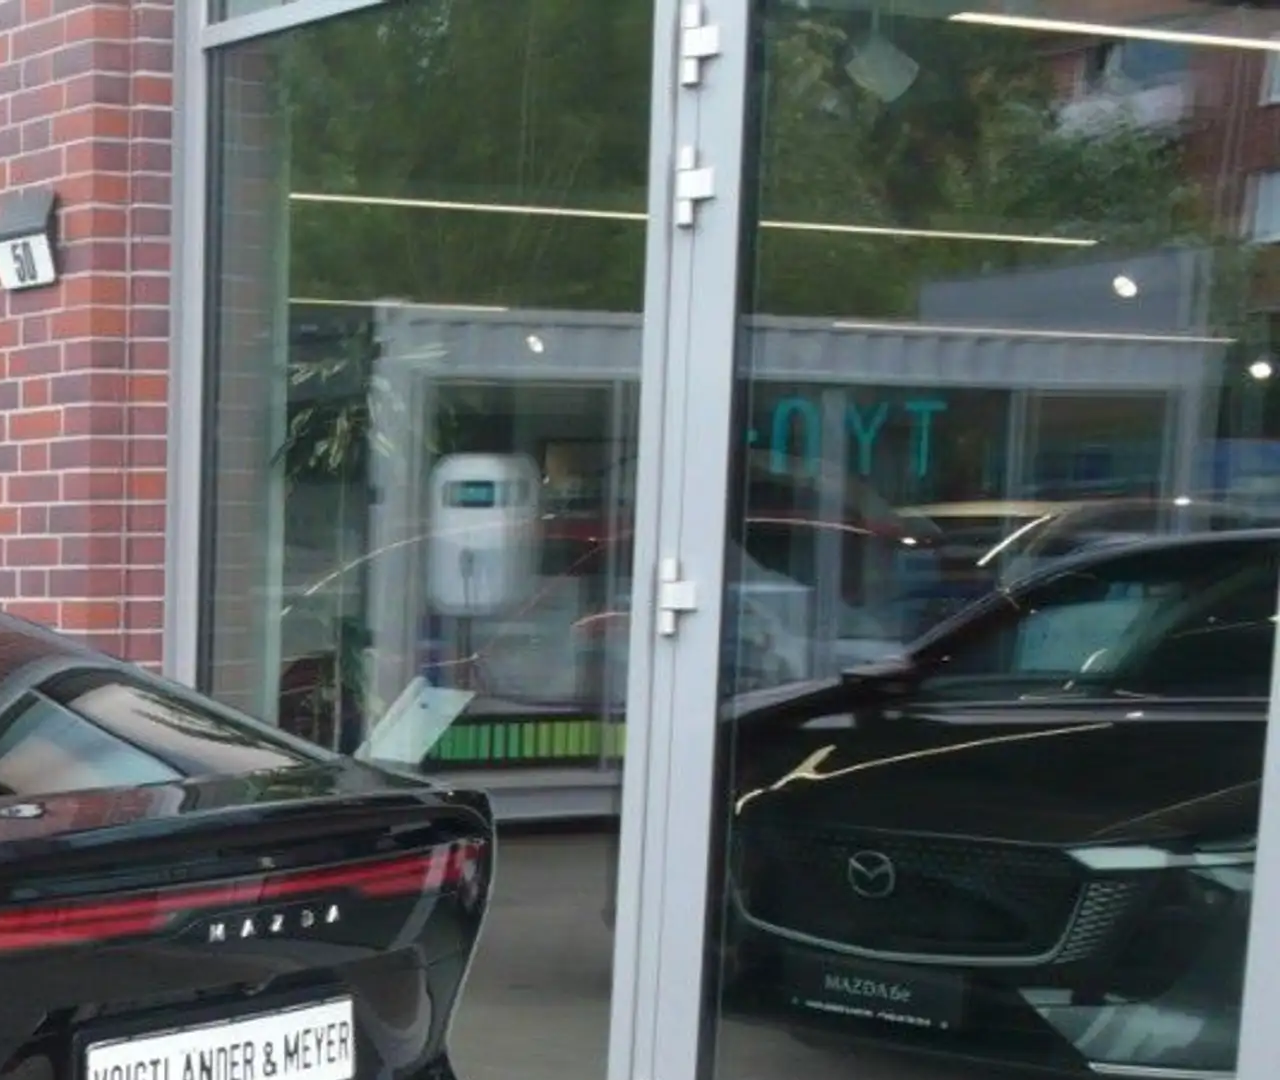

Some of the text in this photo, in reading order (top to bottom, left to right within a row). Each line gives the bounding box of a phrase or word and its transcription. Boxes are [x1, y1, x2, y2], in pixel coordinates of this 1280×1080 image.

[10, 241, 38, 283] 50
[209, 904, 339, 943] MAZDA
[262, 1041, 277, 1077] &
[284, 1020, 349, 1073] MEYER
